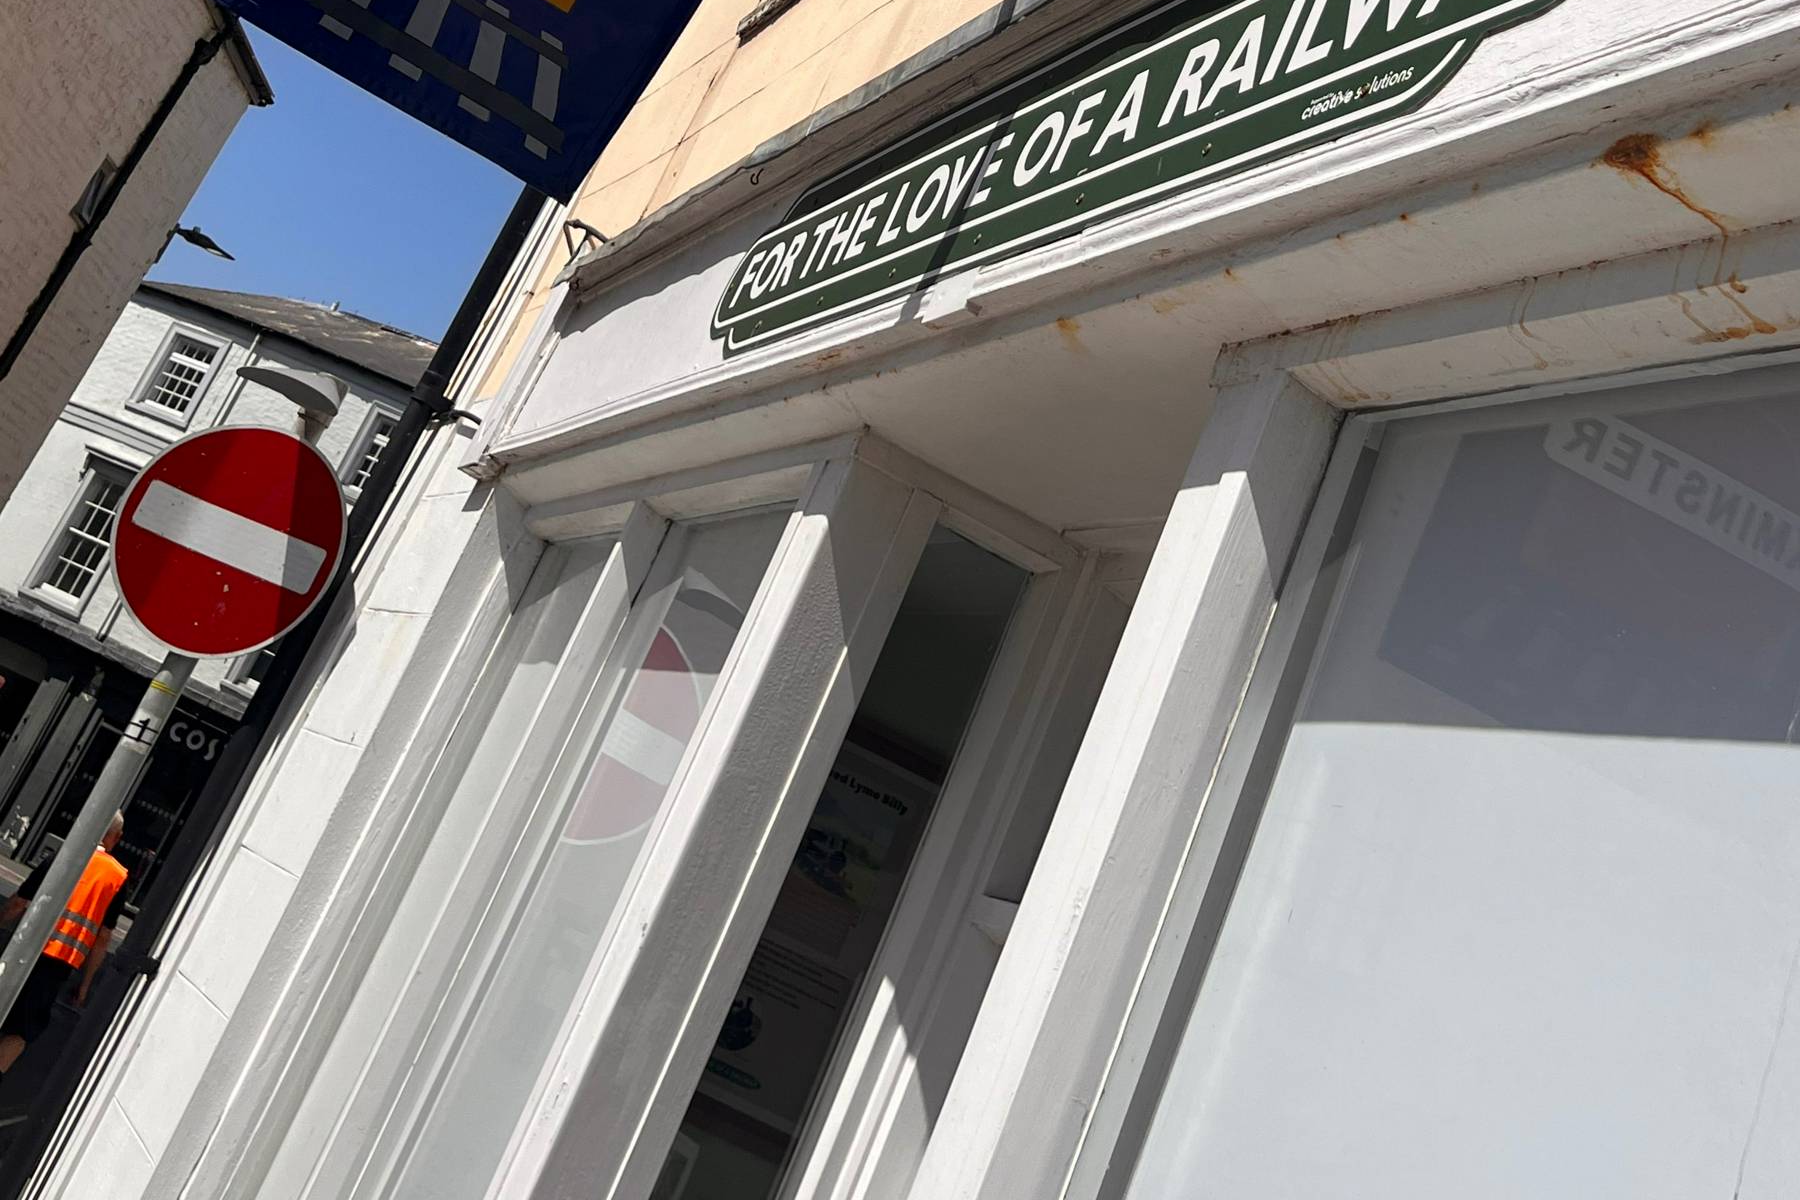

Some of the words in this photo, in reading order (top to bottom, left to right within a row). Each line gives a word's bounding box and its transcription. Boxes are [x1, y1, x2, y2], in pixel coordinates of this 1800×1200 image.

[1301, 89, 1354, 120] creative
[1354, 66, 1415, 100] slutions
[729, 231, 808, 309] FOR
[800, 192, 888, 280] THE
[876, 133, 1015, 246] LOVE
[1013, 90, 1106, 188] OF
[1090, 69, 1150, 157] A
